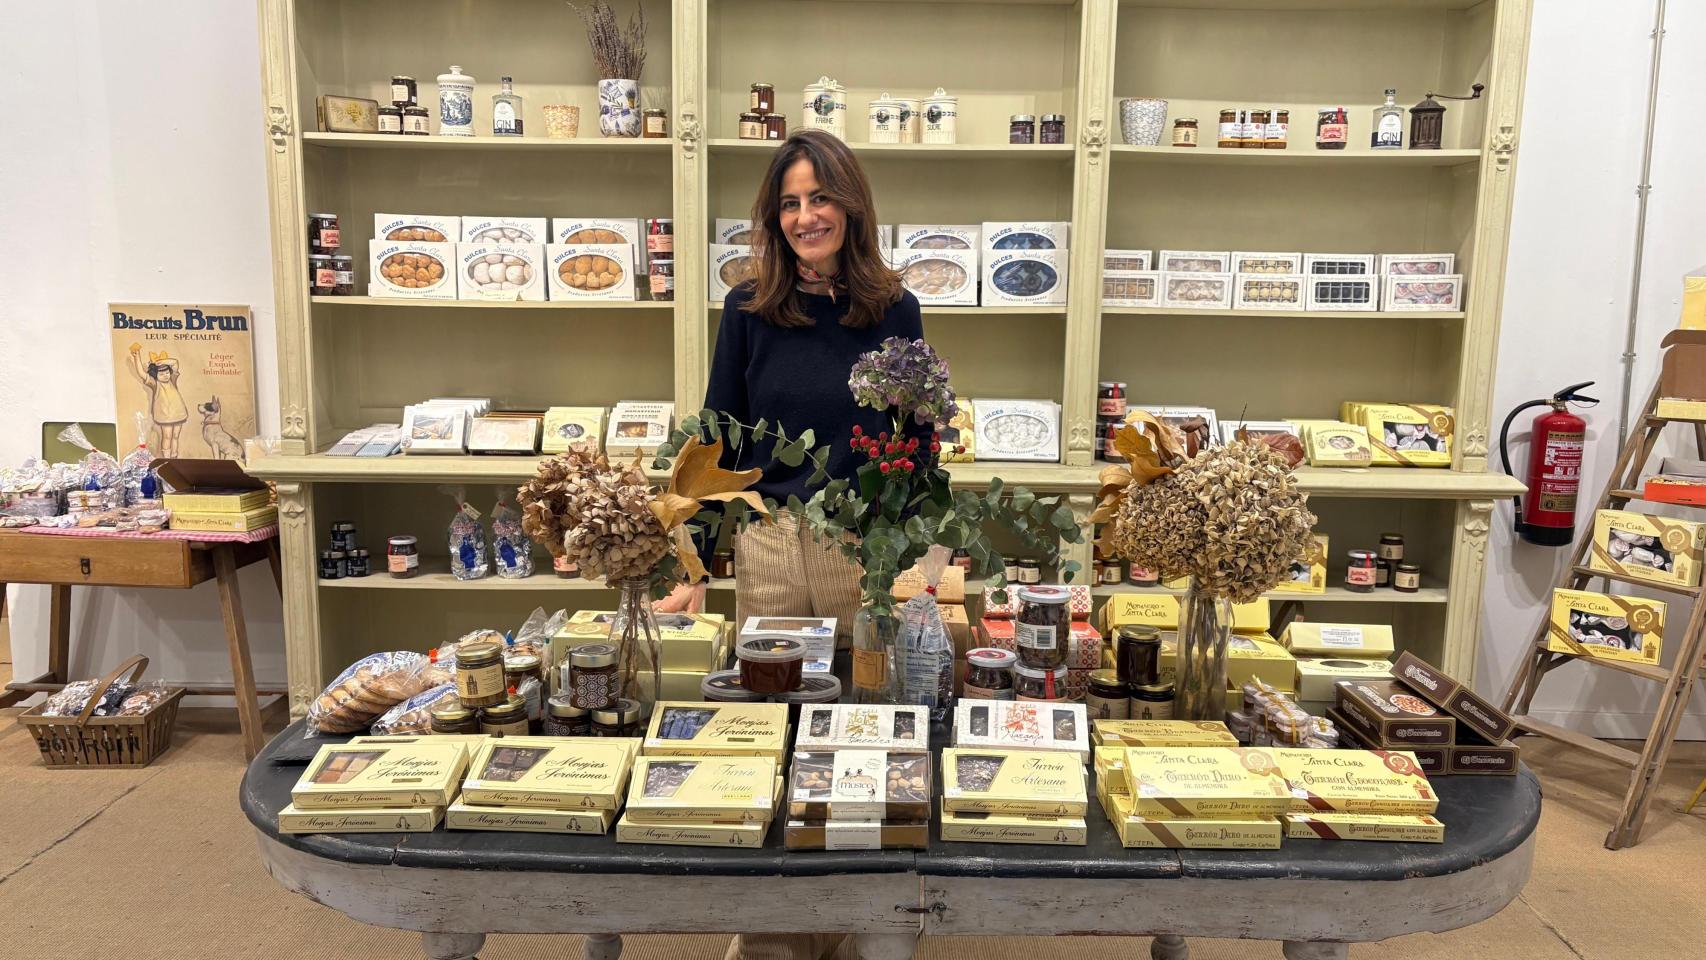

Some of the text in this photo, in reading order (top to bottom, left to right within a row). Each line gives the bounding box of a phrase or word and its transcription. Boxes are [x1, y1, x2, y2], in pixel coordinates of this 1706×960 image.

[496, 120, 510, 128] GIN
[1381, 132, 1398, 141] GIN
[382, 220, 404, 234] DULCES
[468, 222, 492, 236] DULCES
[560, 224, 582, 238] DULCES
[722, 224, 744, 238] DULCES
[906, 229, 928, 244] DULCES
[989, 227, 1012, 242] DULCES
[376, 246, 400, 260] DULCES
[464, 248, 486, 262] DULCES
[554, 248, 576, 264] DULCES
[716, 249, 739, 263] DULCES
[990, 254, 1013, 270] DULCES
[112, 309, 248, 331] Biscuits Brun
[174, 332, 222, 341] SPÉCIALITÉ
[210, 352, 234, 362] Léger
[208, 361, 236, 369] Exquis
[981, 408, 1004, 422] DULCES
[715, 716, 771, 728] Monjas
[708, 726, 776, 737] Jerónimas
[378, 756, 439, 769] Monjas
[546, 756, 608, 768] Monjas
[1022, 757, 1064, 772] Turrón
[1334, 758, 1366, 767] CLARA
[368, 766, 441, 780] Jerónimas
[536, 768, 611, 780] Jerónimas
[1011, 775, 1066, 786] Artesano
[484, 793, 518, 802] Monjas
[299, 817, 334, 828] Monjas
[468, 815, 504, 826] Monjas
[636, 829, 670, 839] Monjas
[962, 827, 994, 836] Monjas
